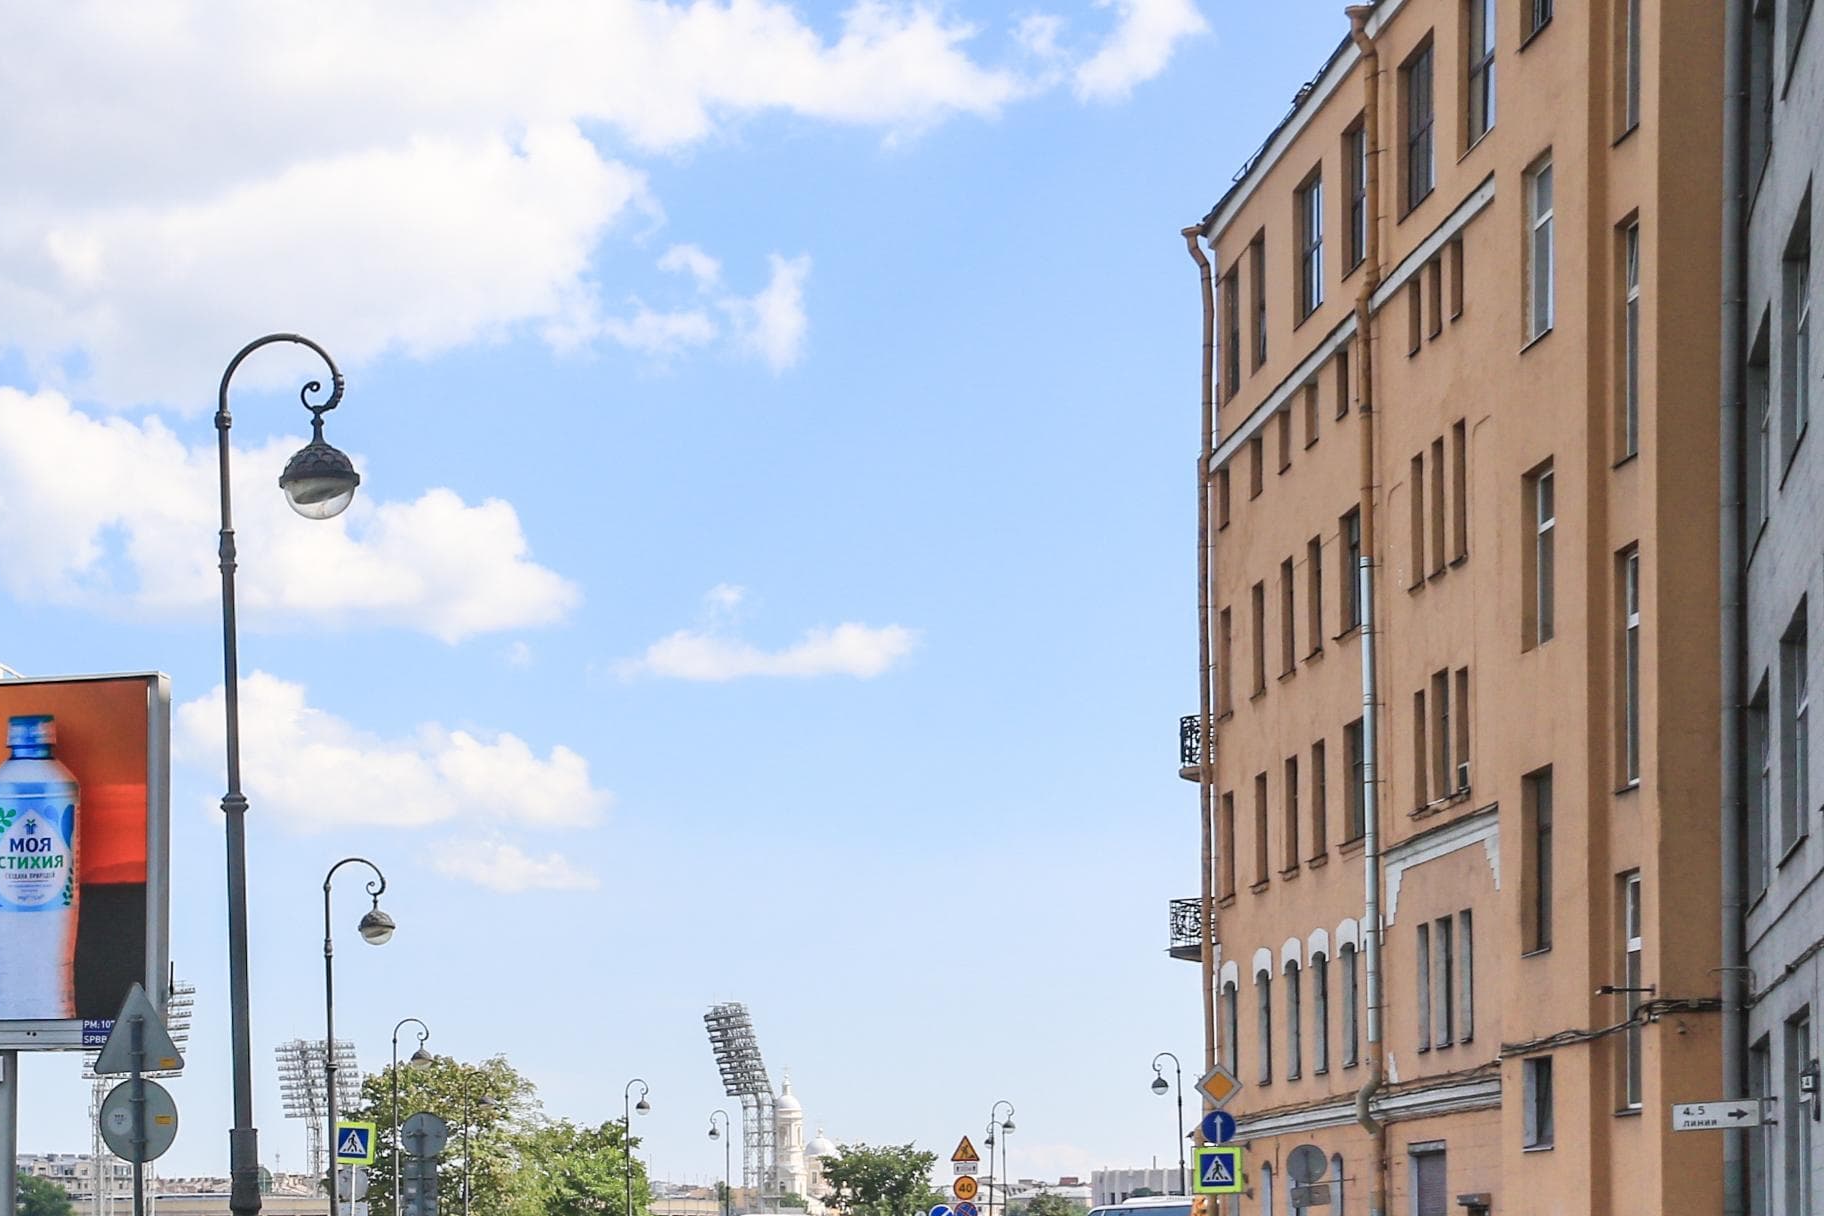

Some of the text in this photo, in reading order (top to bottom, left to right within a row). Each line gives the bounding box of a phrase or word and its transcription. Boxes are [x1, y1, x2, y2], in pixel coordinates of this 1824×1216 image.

[10, 837, 52, 853] МОЯ
[1683, 1119, 1717, 1128] линии
[959, 1183, 973, 1193] 40
